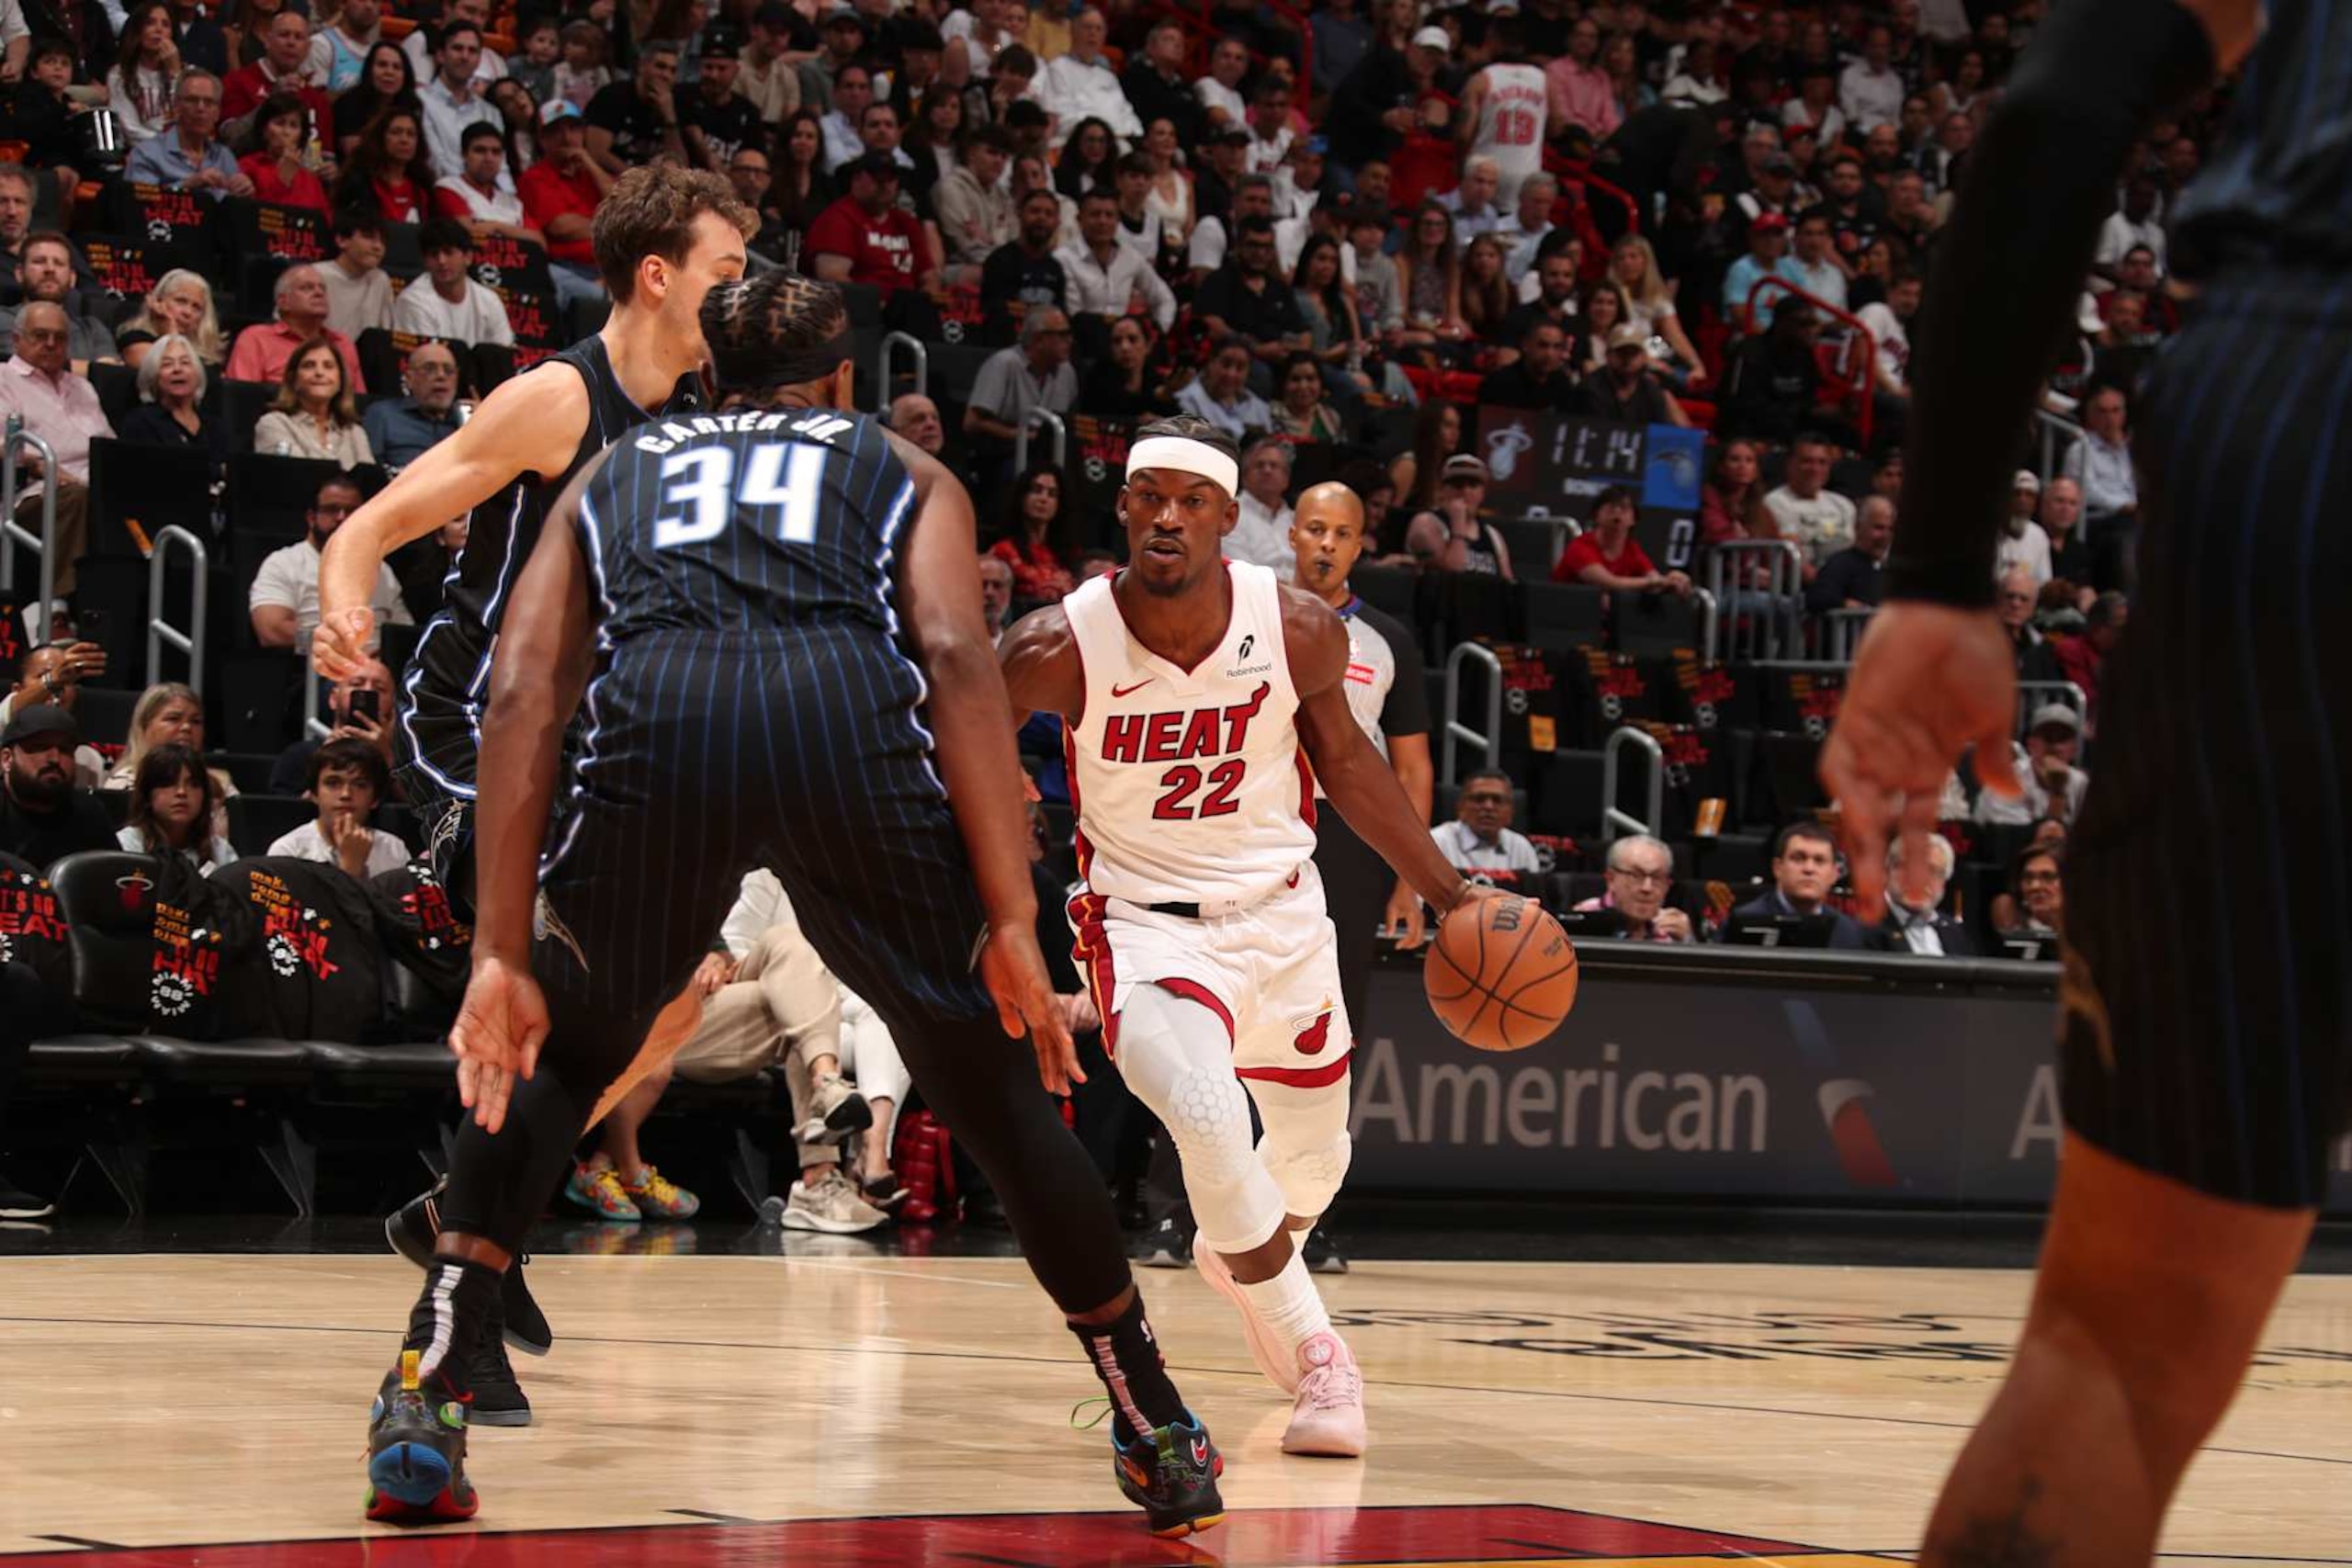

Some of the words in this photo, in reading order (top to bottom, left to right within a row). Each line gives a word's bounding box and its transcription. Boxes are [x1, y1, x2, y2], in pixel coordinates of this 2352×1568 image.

[1495, 109, 1536, 145] 13
[635, 410, 787, 454] CARTER
[790, 413, 854, 445] JR.
[652, 444, 828, 549] 34
[1227, 663, 1272, 679] Robinhood
[1102, 680, 1271, 764] HEAT
[1152, 758, 1246, 819] 22
[1351, 1037, 1768, 1153] American
